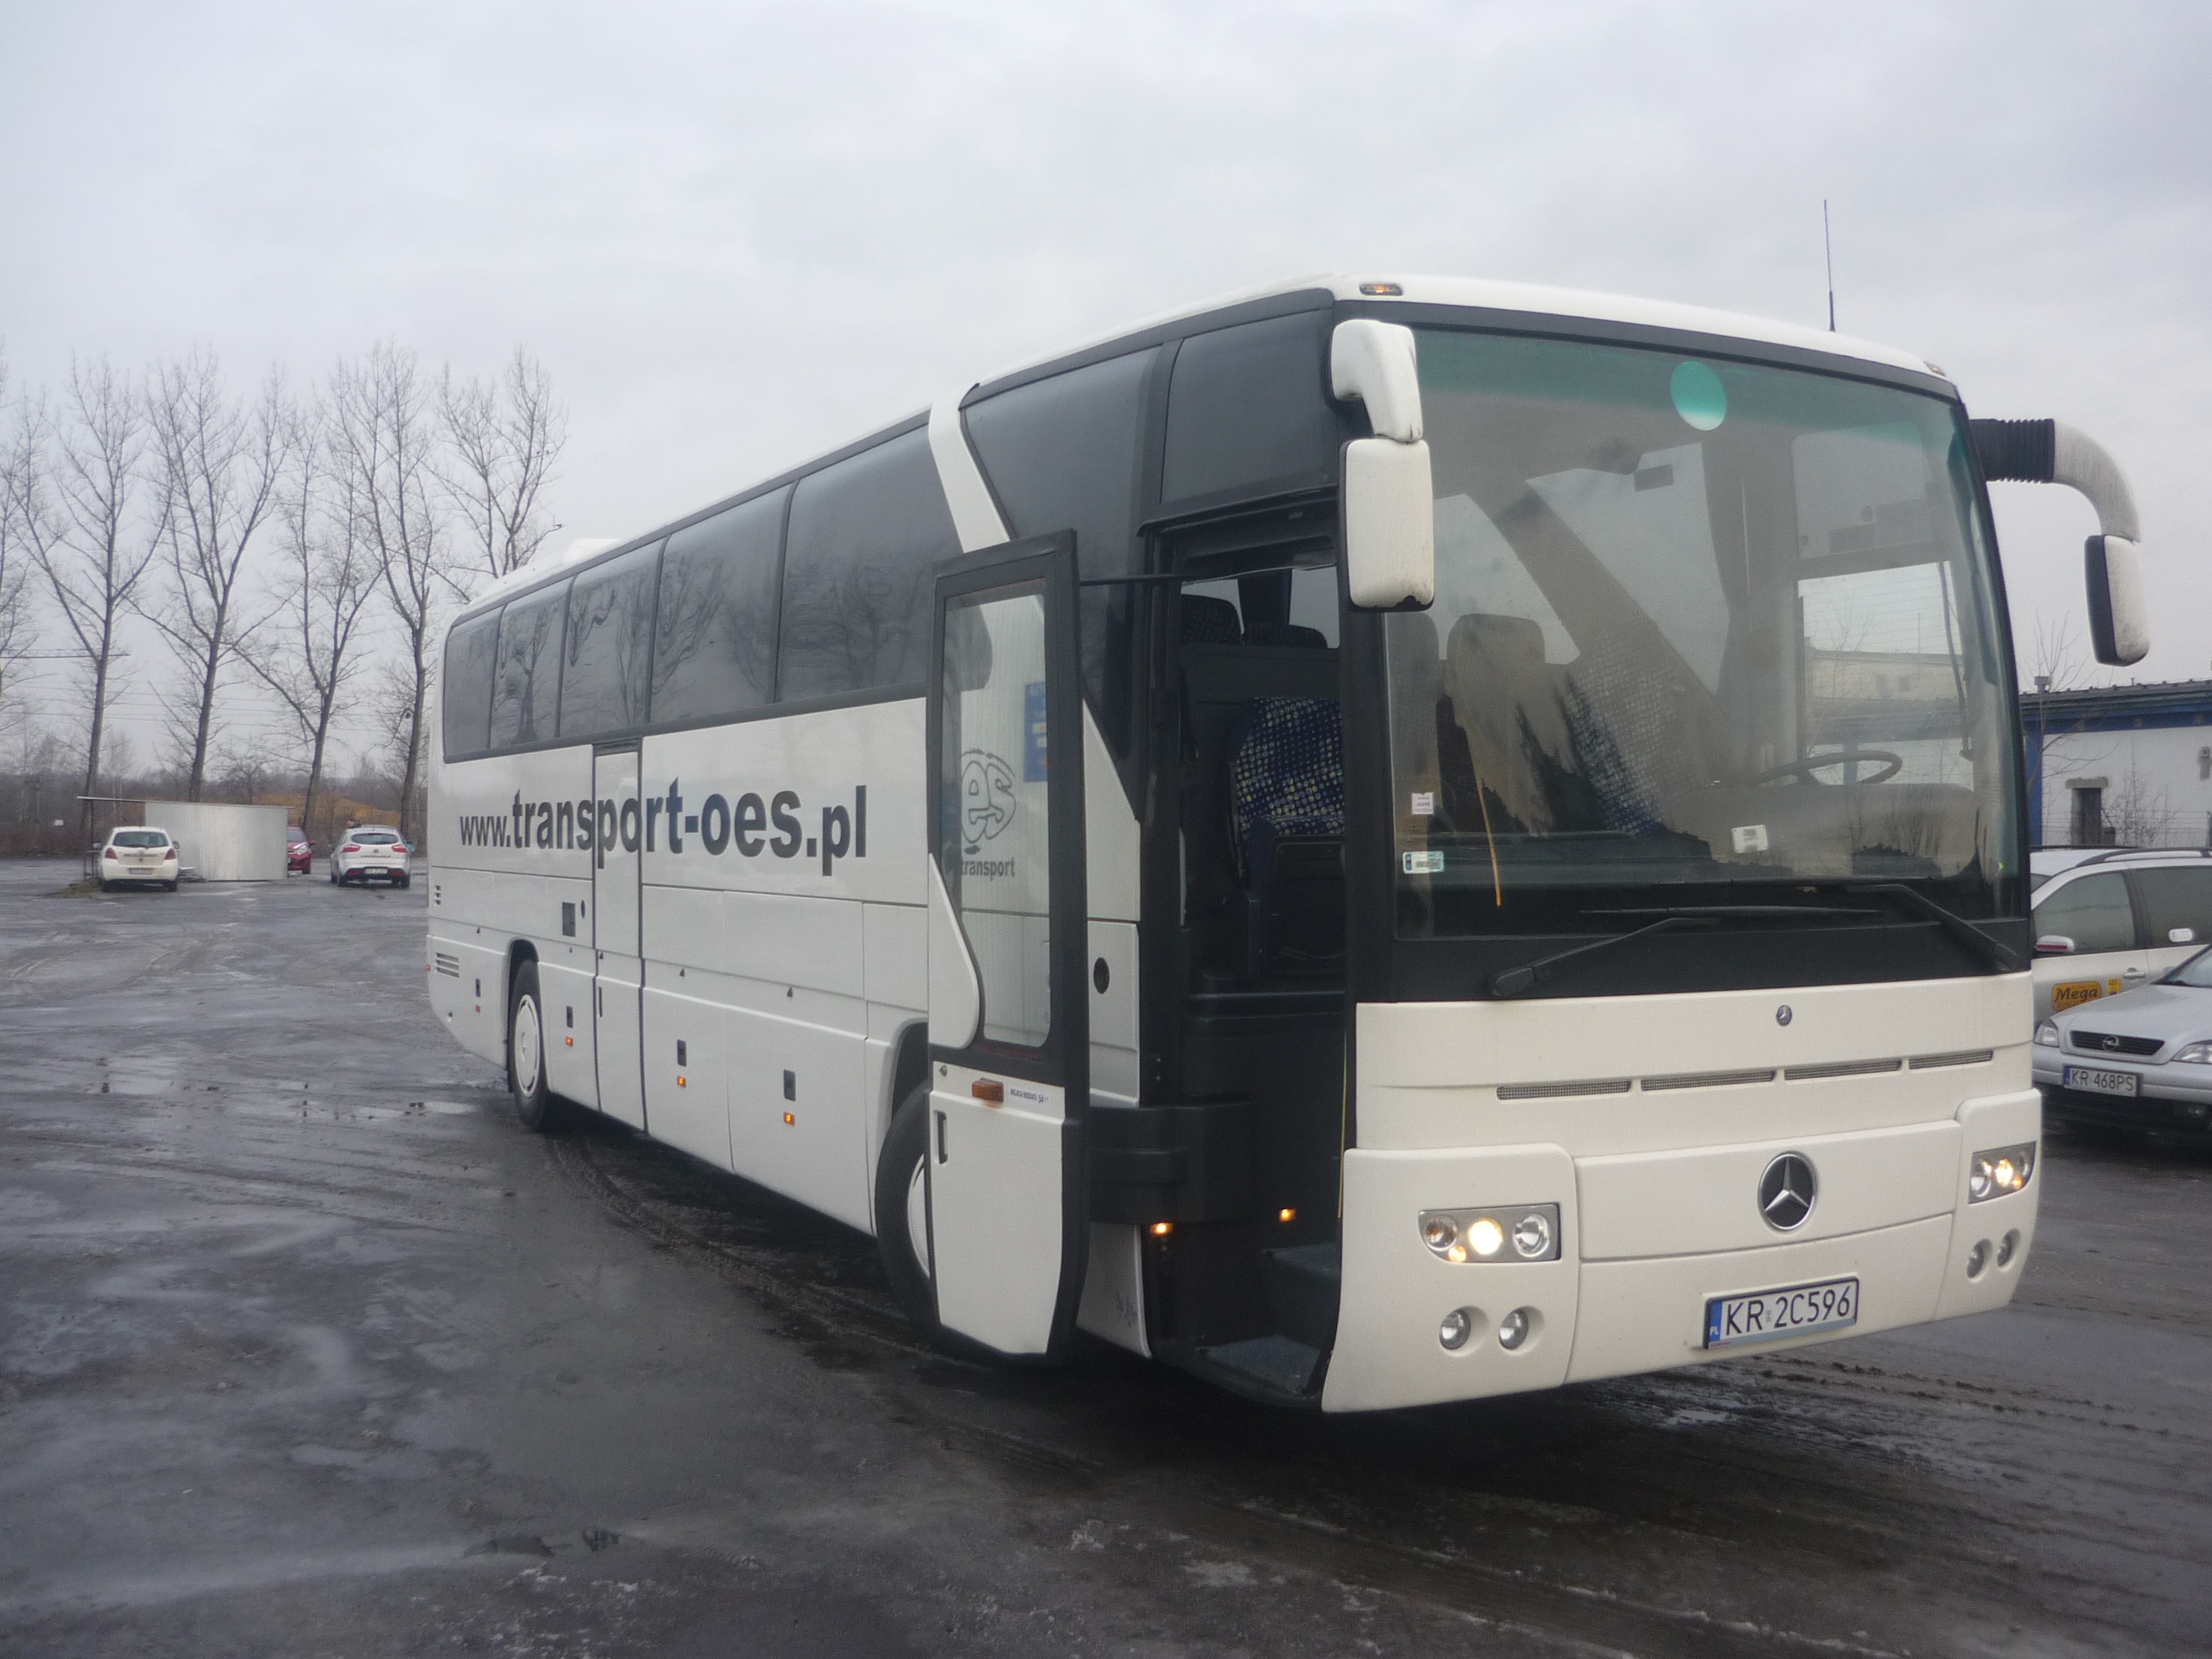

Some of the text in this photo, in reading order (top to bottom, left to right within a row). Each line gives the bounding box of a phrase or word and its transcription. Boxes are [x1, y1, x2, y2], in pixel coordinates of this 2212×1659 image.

[459, 776, 867, 876] www.transport-oes.pl
[2054, 987, 2098, 1004] Mega
[2070, 1069, 2134, 1092] KR 468PS
[1726, 1285, 1851, 1335] KR 2C596
[1709, 1326, 1719, 1335] PL
